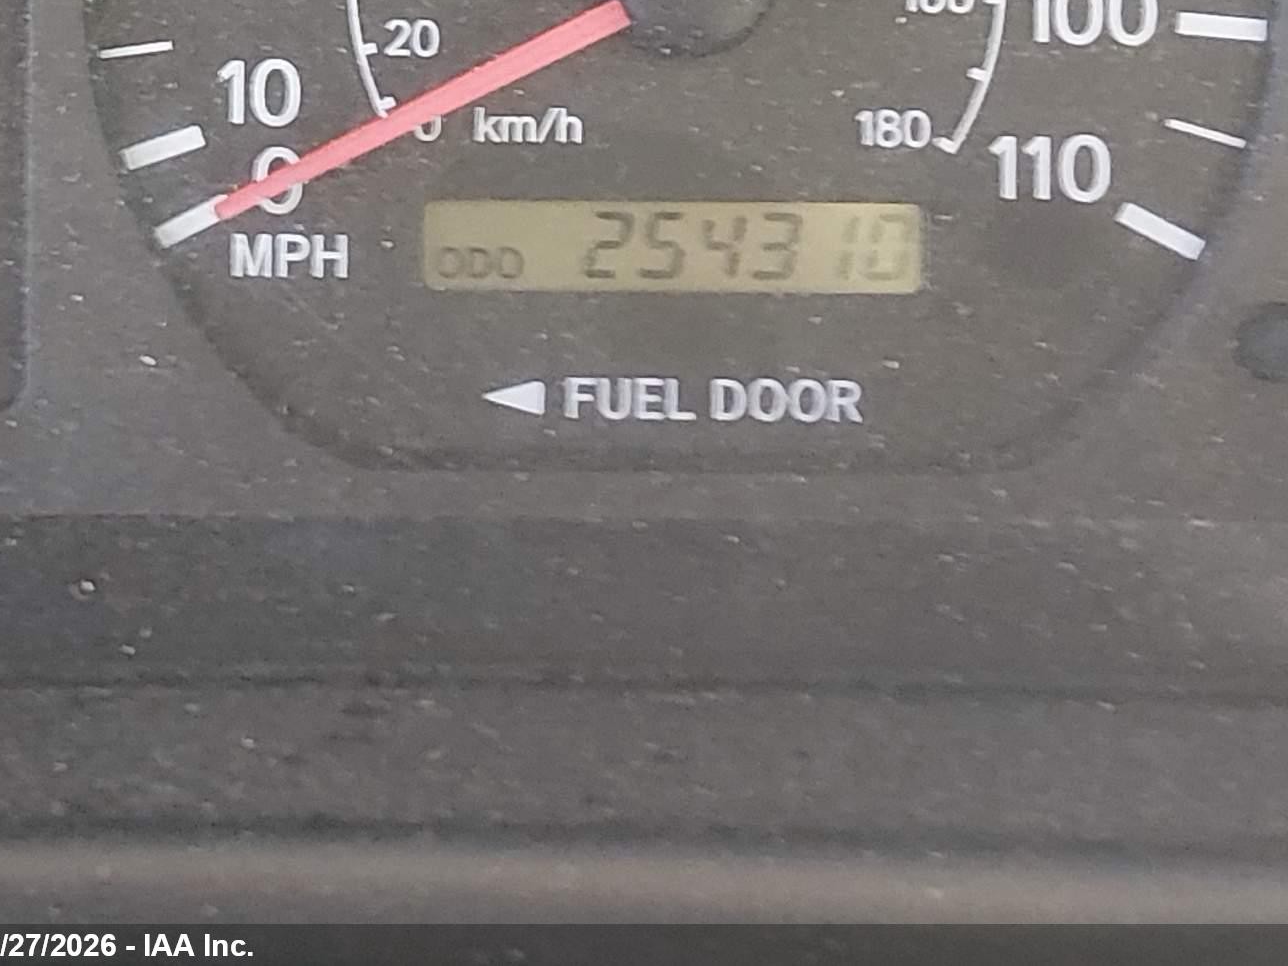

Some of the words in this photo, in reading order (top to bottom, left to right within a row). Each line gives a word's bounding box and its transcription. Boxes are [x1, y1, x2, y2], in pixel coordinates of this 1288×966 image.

[384, 20, 439, 57] 20
[218, 59, 300, 126] 10
[475, 107, 582, 143] km/h
[856, 110, 931, 147] 180
[989, 135, 1110, 202] 110
[231, 234, 348, 277] MPH
[438, 247, 525, 279] ODO
[563, 378, 696, 421] FUEL
[711, 379, 862, 422] DOOR
